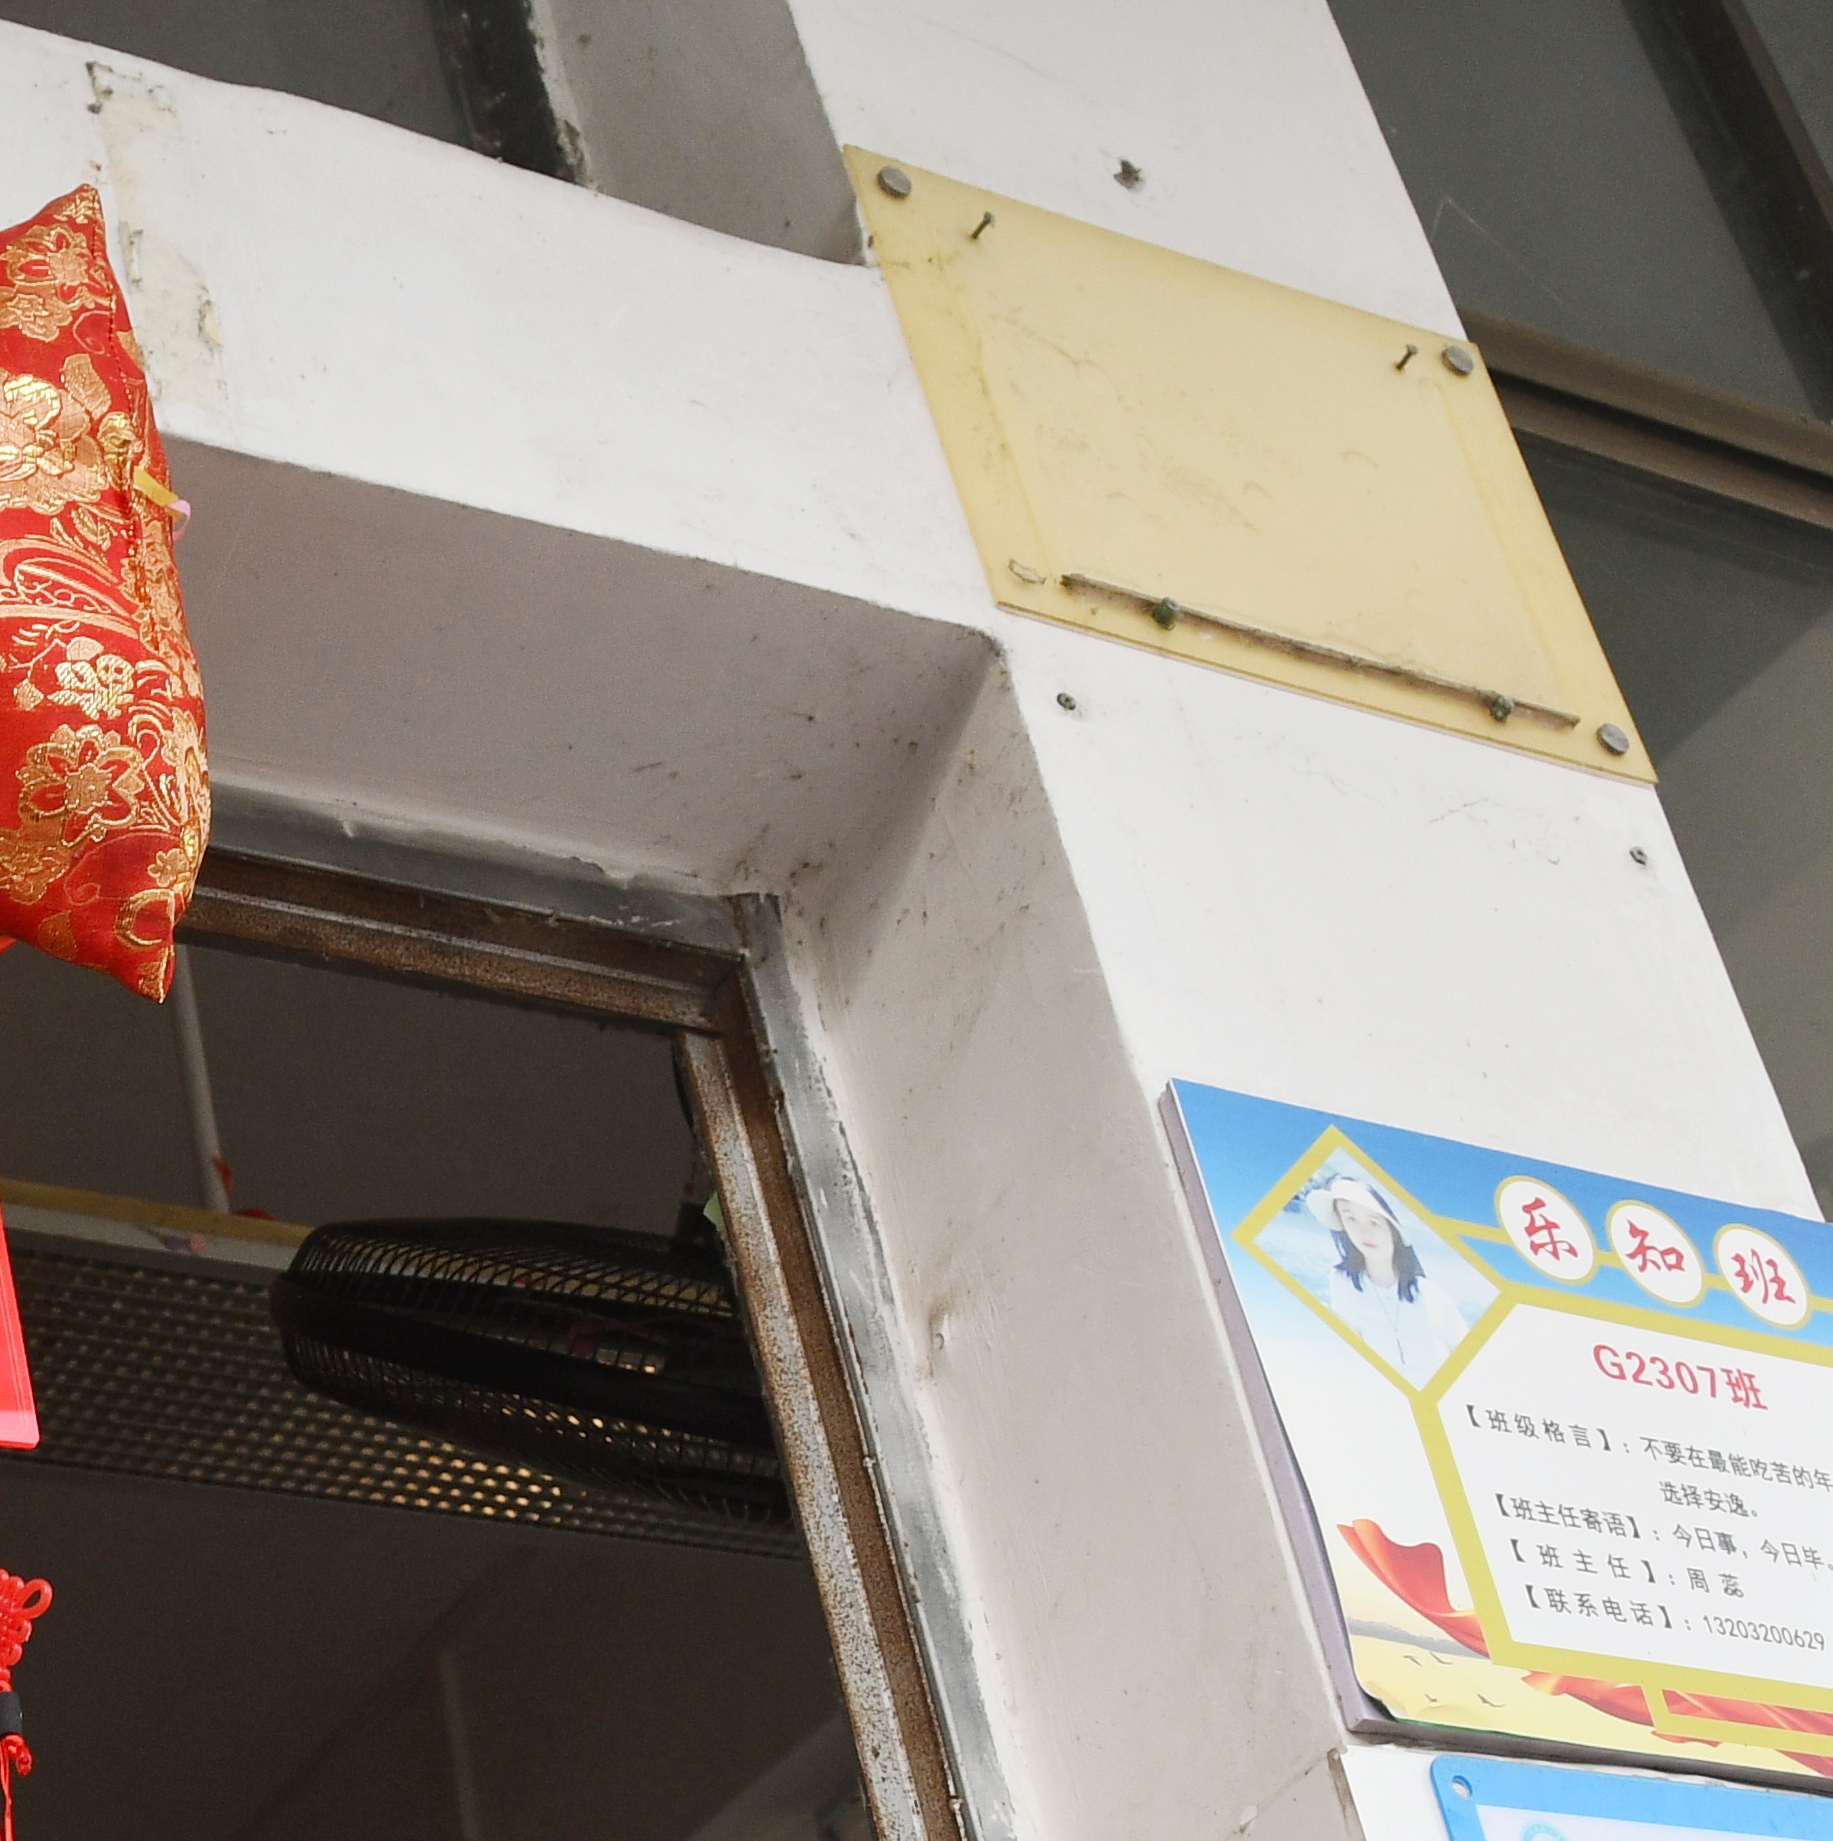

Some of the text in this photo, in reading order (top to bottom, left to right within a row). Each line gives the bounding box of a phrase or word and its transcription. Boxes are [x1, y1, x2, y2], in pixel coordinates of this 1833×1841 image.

[1521, 1196, 1796, 1304] 乐知班
[1593, 1343, 1769, 1410] G2307班
